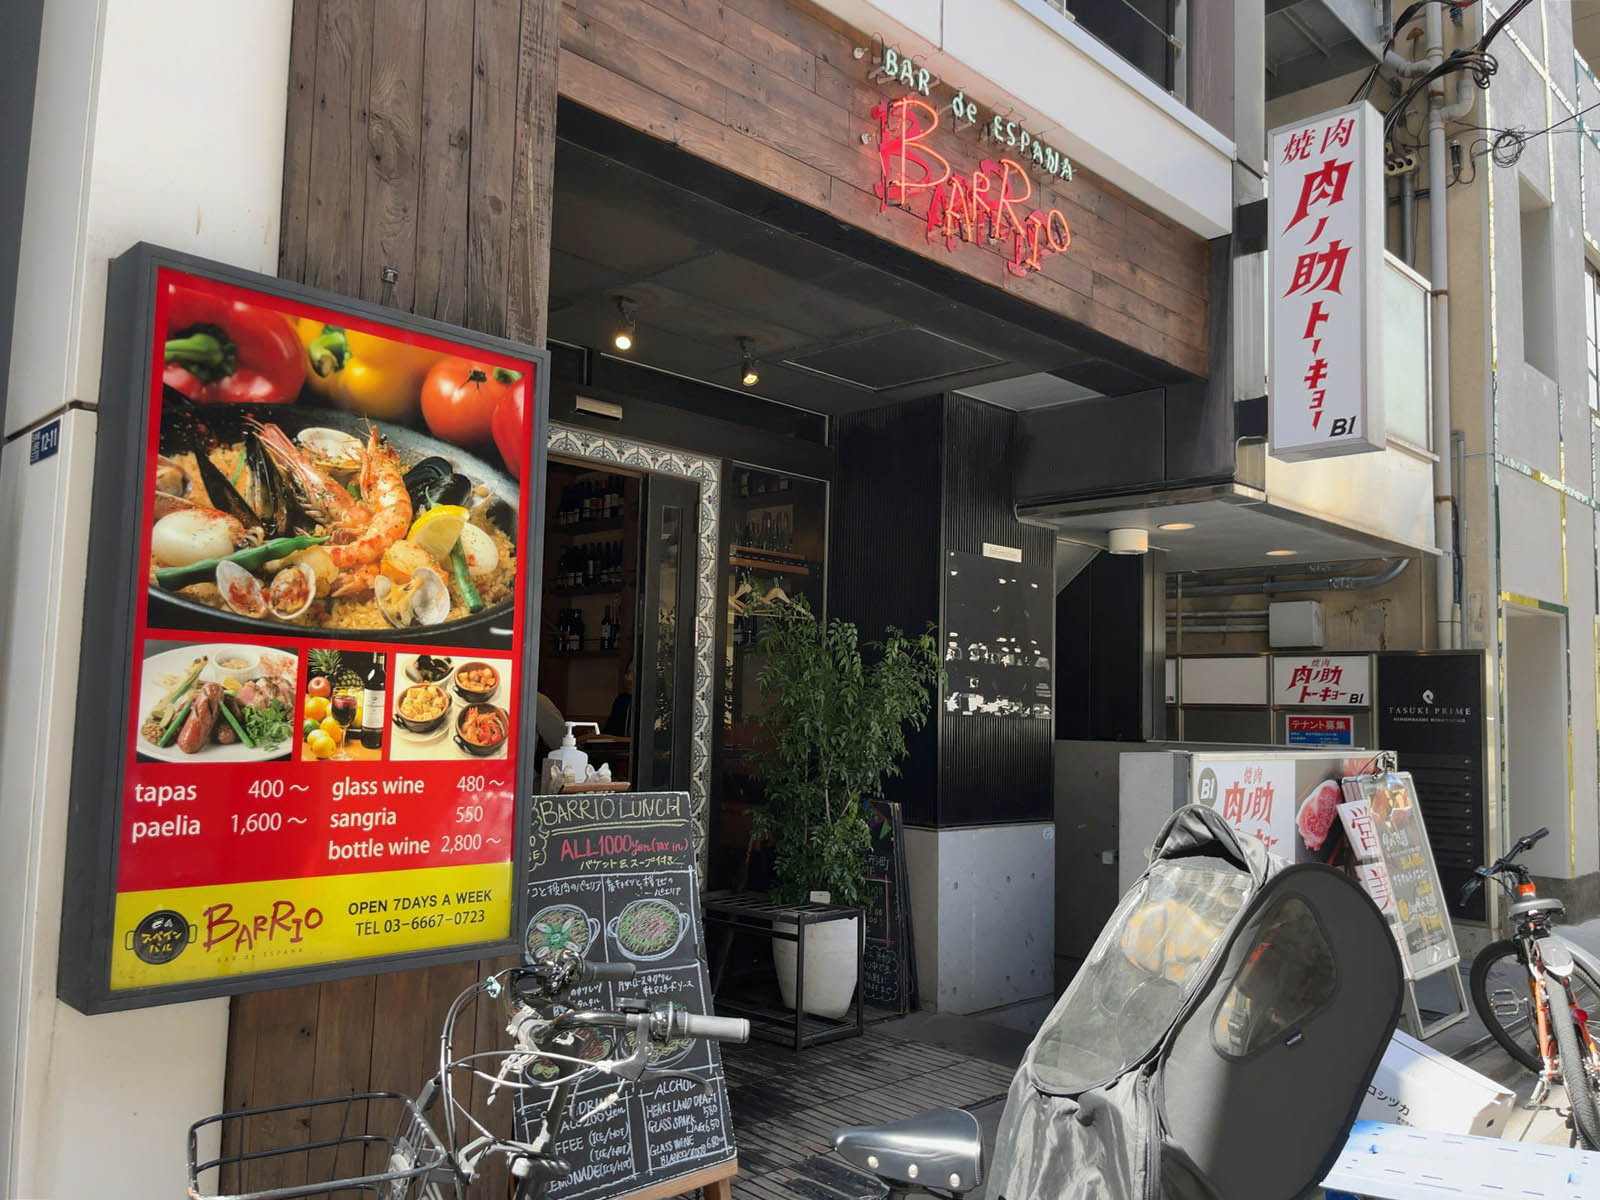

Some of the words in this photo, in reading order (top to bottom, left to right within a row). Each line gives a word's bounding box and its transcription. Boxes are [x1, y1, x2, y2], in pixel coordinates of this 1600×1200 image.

[885, 49, 930, 96] BAR
[952, 92, 978, 124] de
[1282, 117, 1356, 166] 焼肉
[1329, 415, 1357, 438] B1
[1284, 665, 1344, 692] 肉ノ助
[1298, 685, 1350, 704] トーキョー
[1348, 693, 1365, 704] B1
[1387, 706, 1429, 715] TASUKI
[1434, 707, 1472, 716] PRIME
[1291, 719, 1346, 730] テナント募集
[135, 783, 197, 807] tapas
[332, 776, 378, 801] glass
[382, 776, 425, 795] wine
[1200, 777, 1216, 800] B1
[540, 798, 615, 826] BARRIO
[619, 796, 681, 819] LUNCH
[1223, 781, 1275, 824] 肉ノ助
[132, 814, 200, 843] paelia
[330, 807, 397, 831] sangria
[455, 805, 484, 823] 550
[328, 837, 384, 860] bottle
[388, 836, 431, 856] wine
[348, 899, 388, 916] OPEN
[393, 894, 438, 911] 7DAYS
[441, 893, 452, 906] A
[455, 889, 493, 905] WEEK
[355, 920, 380, 936] TEL
[384, 909, 486, 934] 03-6667-0723
[141, 930, 183, 944] スペイン
